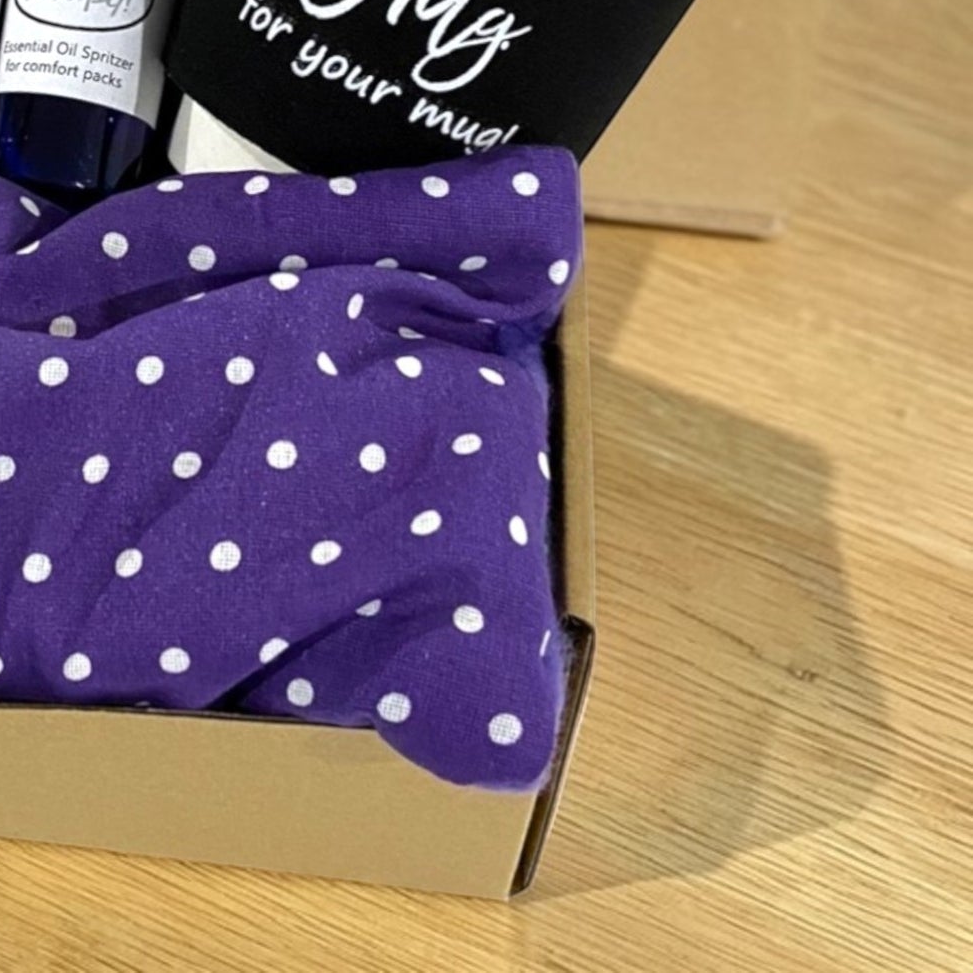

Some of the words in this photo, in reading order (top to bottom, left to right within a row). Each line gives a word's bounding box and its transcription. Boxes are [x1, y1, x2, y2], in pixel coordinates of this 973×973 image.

[3, 40, 53, 55] Essential
[56, 41, 78, 57] Oil
[81, 45, 135, 72] Spritzer
[290, 37, 403, 105] your
[5, 58, 21, 73] for
[22, 60, 79, 78] comfort
[81, 68, 123, 90] packs
